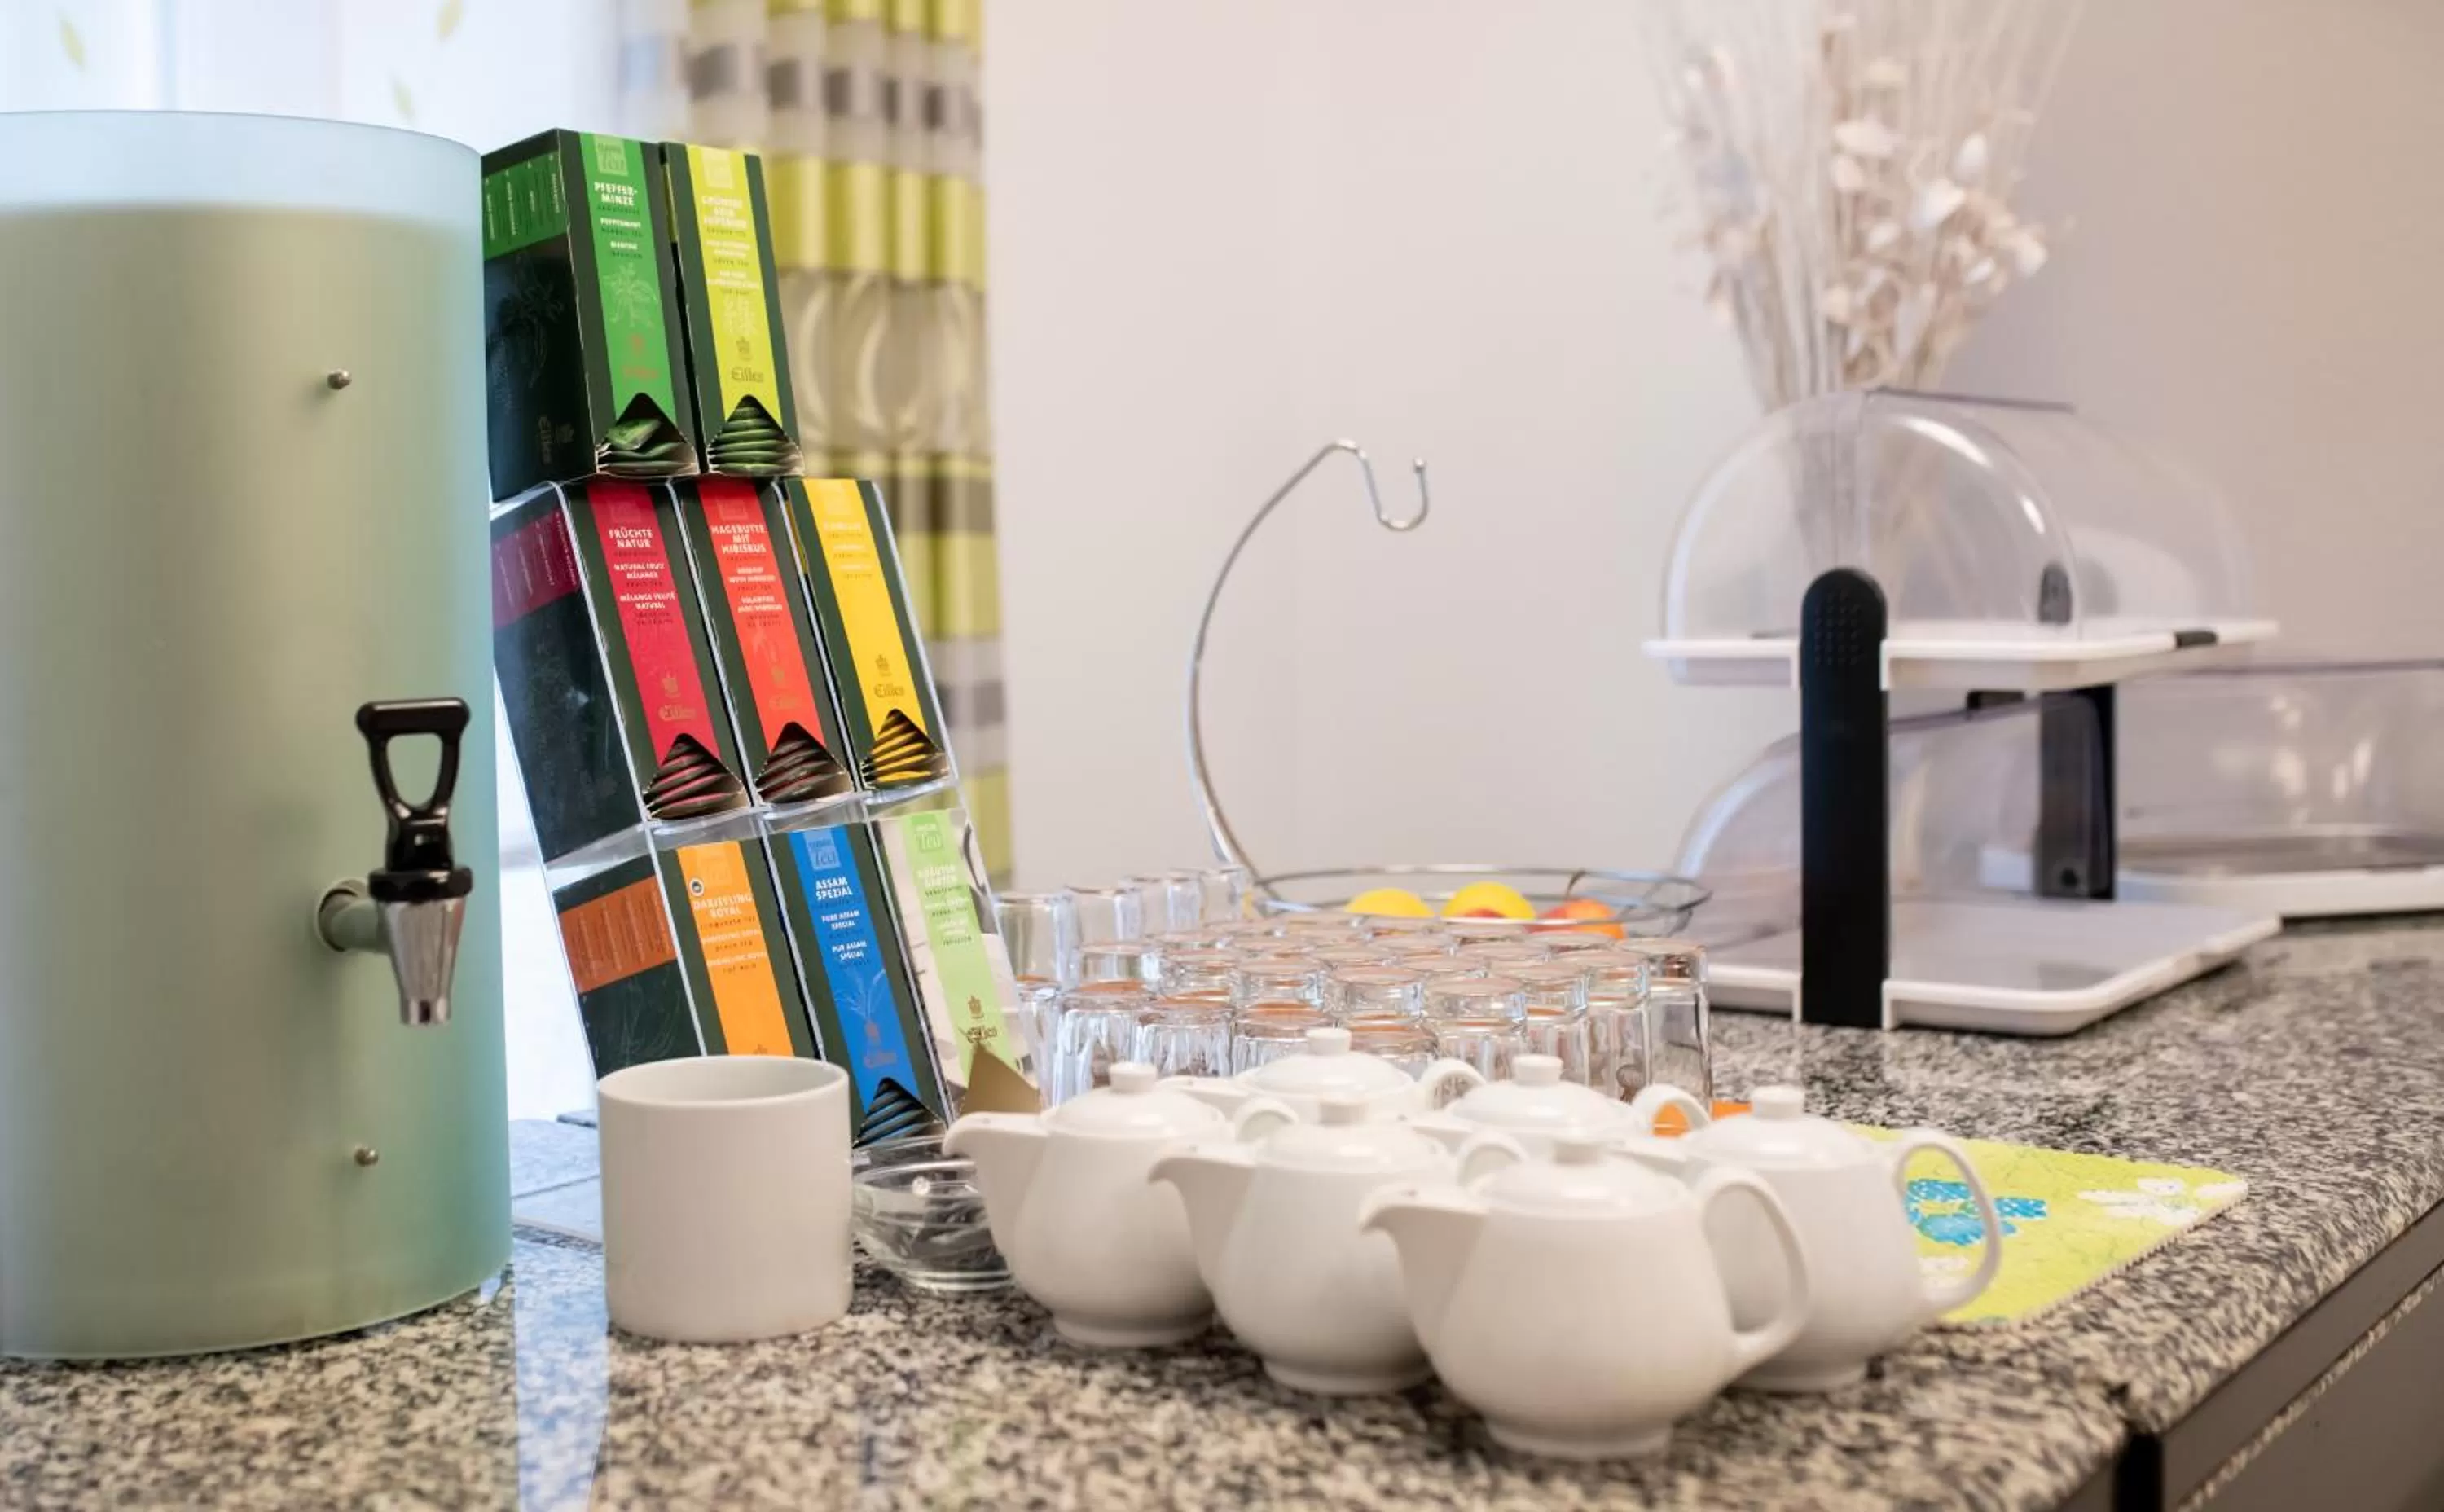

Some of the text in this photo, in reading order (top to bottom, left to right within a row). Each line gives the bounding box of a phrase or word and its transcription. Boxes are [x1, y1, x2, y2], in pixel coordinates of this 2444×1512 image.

[594, 182, 638, 196] PFEFFER-
[601, 194, 634, 205] MINZE
[609, 526, 653, 538] FRÜCHTE
[710, 524, 765, 535] HAGEBUTTE
[617, 538, 651, 548] NATUR
[732, 534, 750, 543] MIT
[873, 683, 904, 699] Eilles
[815, 876, 848, 890] ASSAM
[815, 888, 853, 901] SPEZIAL
[692, 892, 754, 910] DARJEELING
[710, 907, 742, 918] ROYAL
